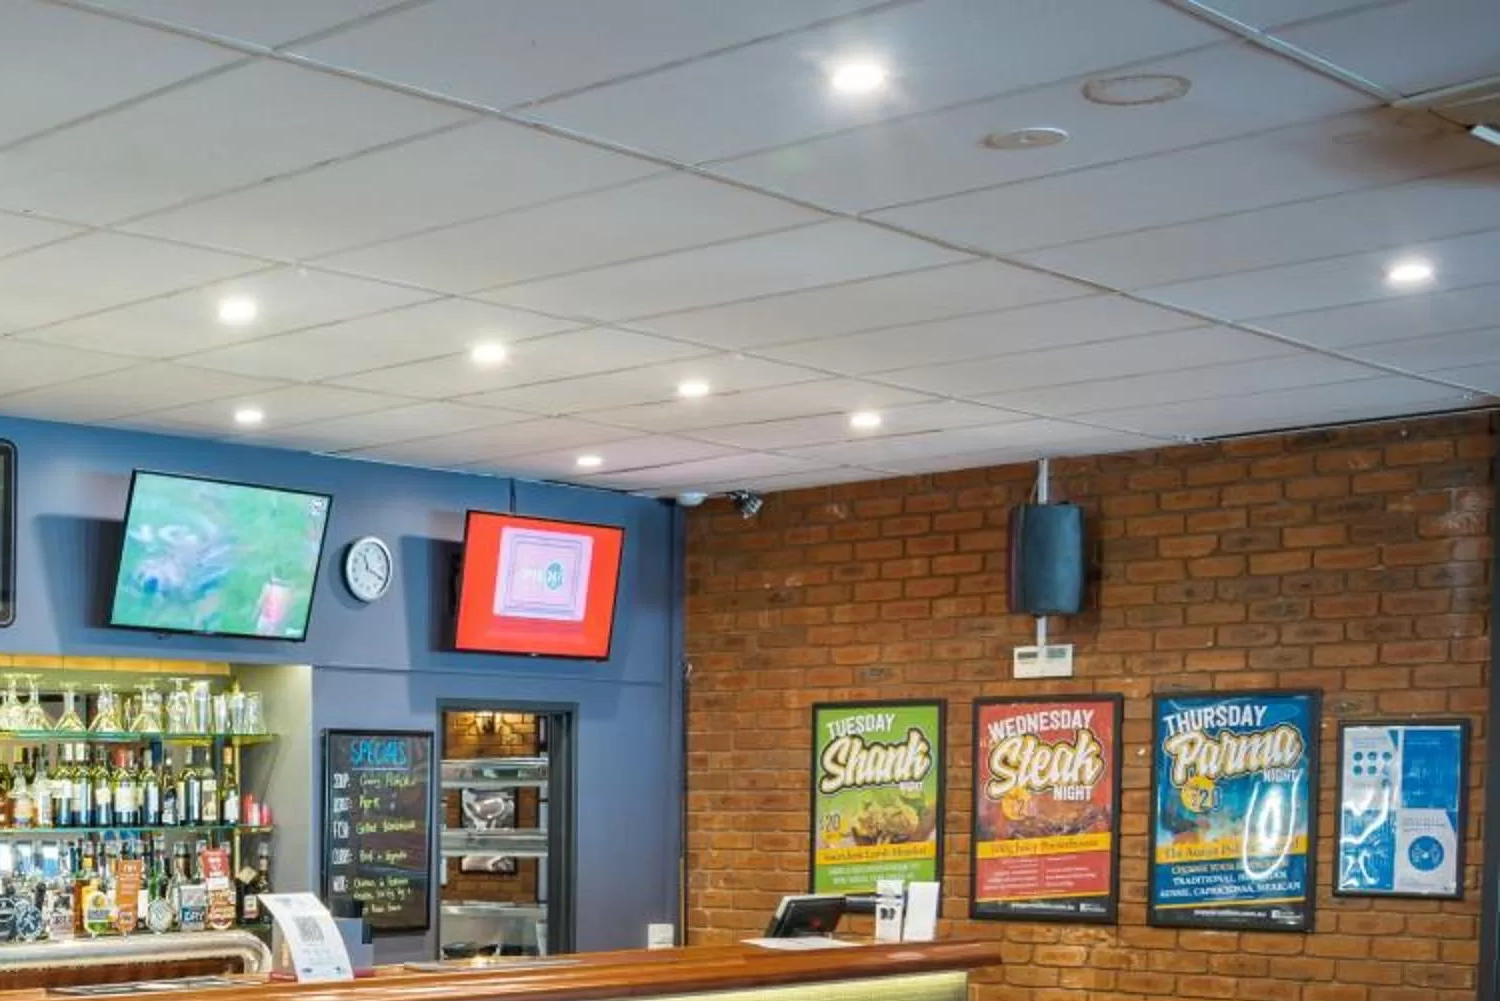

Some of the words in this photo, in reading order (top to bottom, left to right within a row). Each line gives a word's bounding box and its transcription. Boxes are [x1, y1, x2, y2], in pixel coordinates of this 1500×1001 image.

[826, 713, 896, 739] TUESDAY
[987, 708, 1095, 741] WEDNESDAY
[1162, 704, 1268, 736] THURSDAY
[820, 727, 931, 794] Shank
[987, 728, 1104, 800] Steak
[1164, 723, 1304, 786] Parma
[1053, 785, 1093, 801] NIGHT
